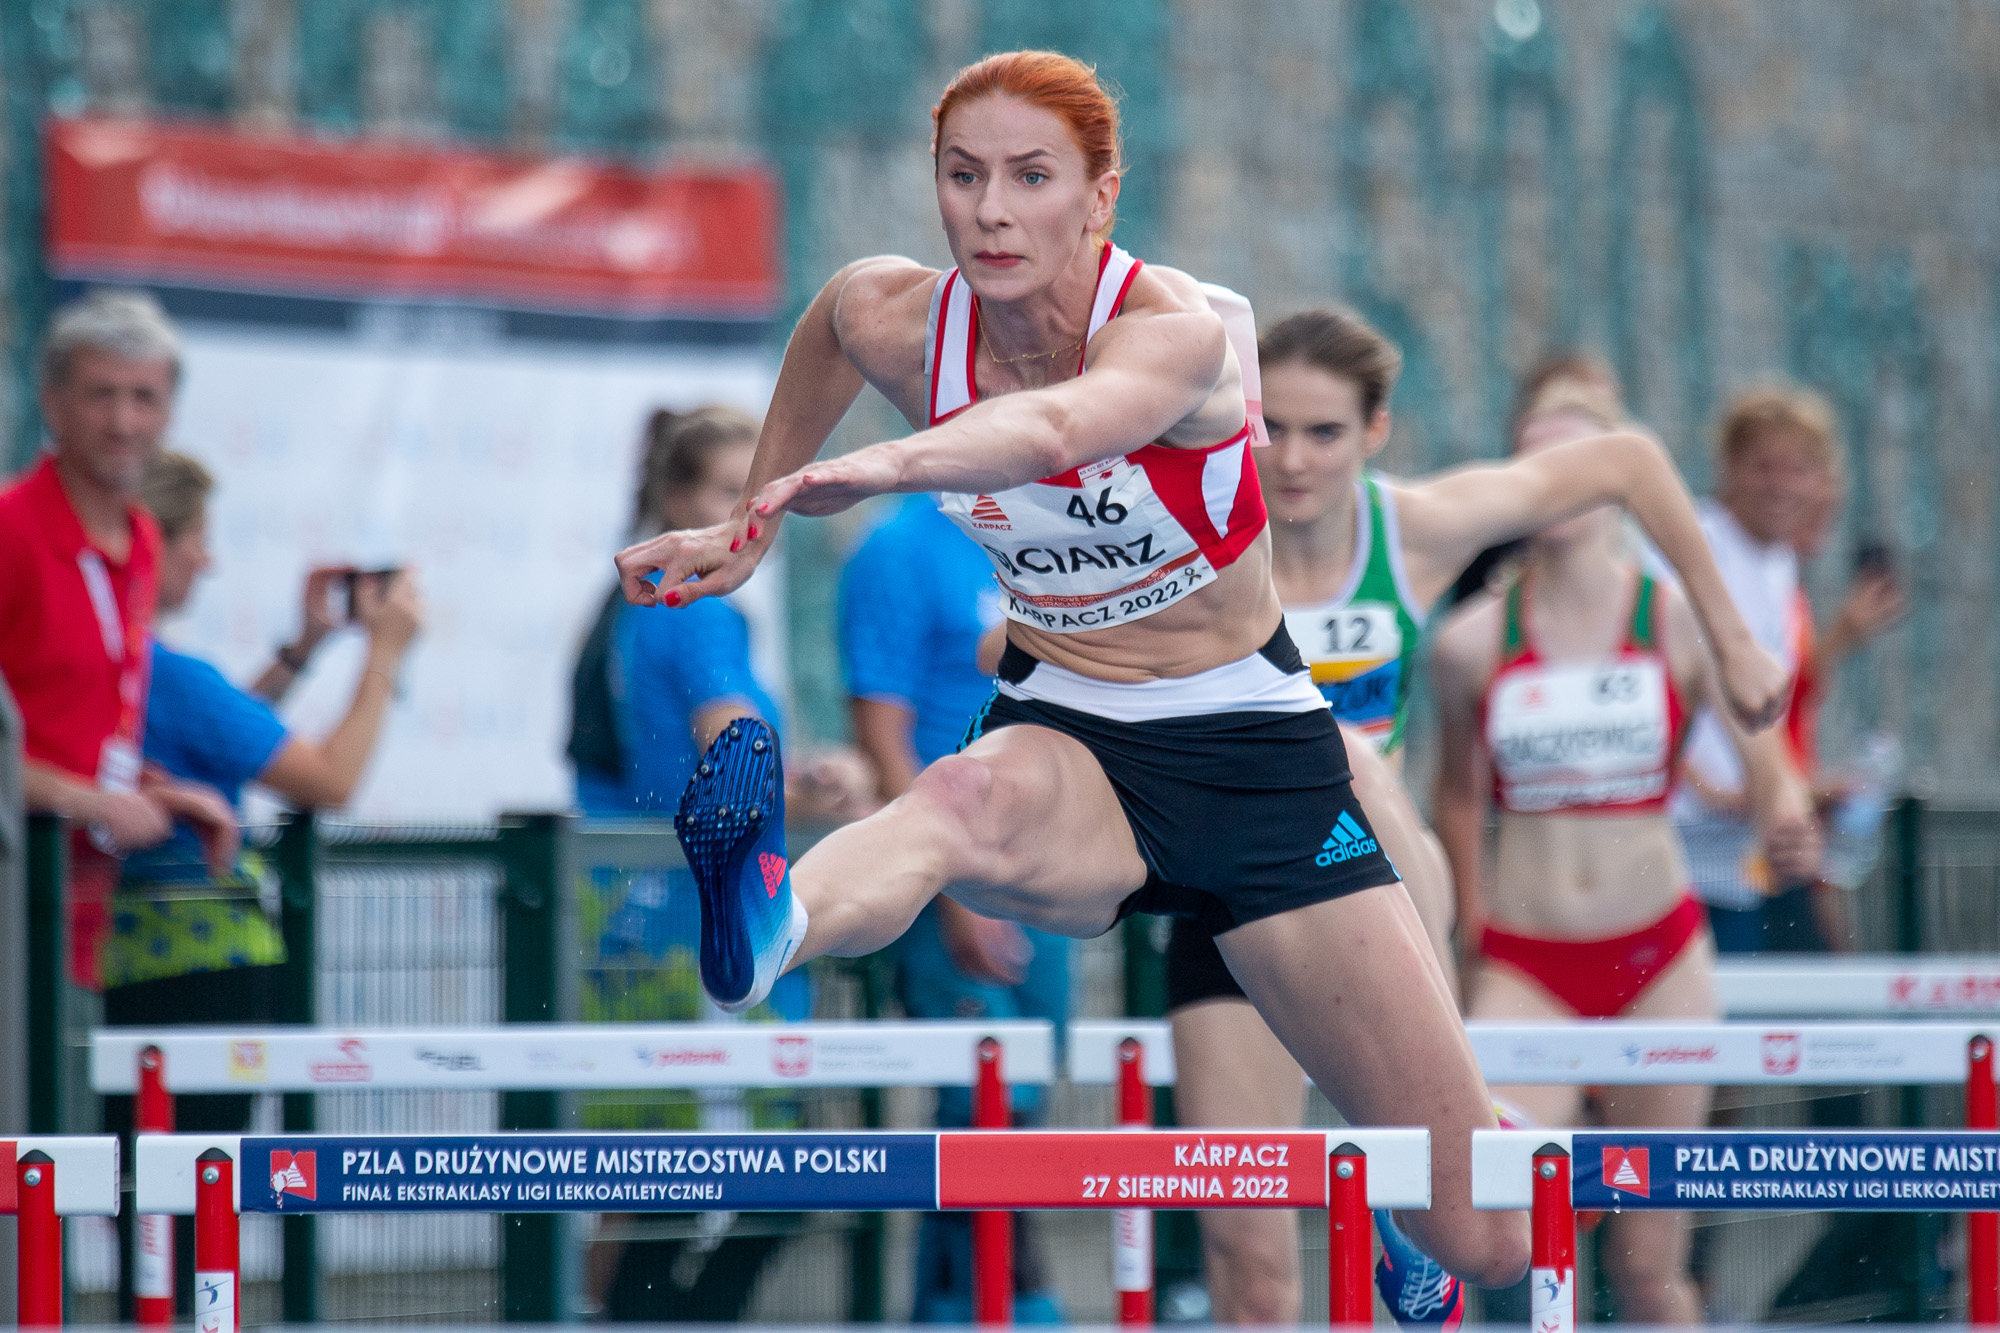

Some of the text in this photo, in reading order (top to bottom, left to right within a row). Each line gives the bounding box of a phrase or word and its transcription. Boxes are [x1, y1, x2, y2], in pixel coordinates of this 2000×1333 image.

[1066, 486, 1128, 528] 46
[972, 522, 1013, 531] KARPACZ
[1009, 594, 1116, 628] KARPACZ
[1120, 580, 1183, 616] 2022
[1321, 617, 1371, 653] 12
[1315, 838, 1378, 867] adidas
[758, 852, 777, 899] adidas
[343, 1144, 887, 1175] PZLA DRUŻYNOWE MISTRZOSTWA POLSKI
[1175, 1146, 1289, 1167] KARPACZ
[1676, 1143, 2000, 1172] PZLA DRUŻYNOWE MIST
[343, 1184, 723, 1201] FINAŁ EKSTRAKLASY LIGI LEKKOATLETYCZNEJ
[1082, 1177, 1289, 1198] 27 SIERPNIA 2022
[1677, 1183, 1727, 1199] FINAŁ
[1732, 1183, 1849, 1199] EKSTRAKLASY
[1855, 1183, 1889, 1198] LIGI
